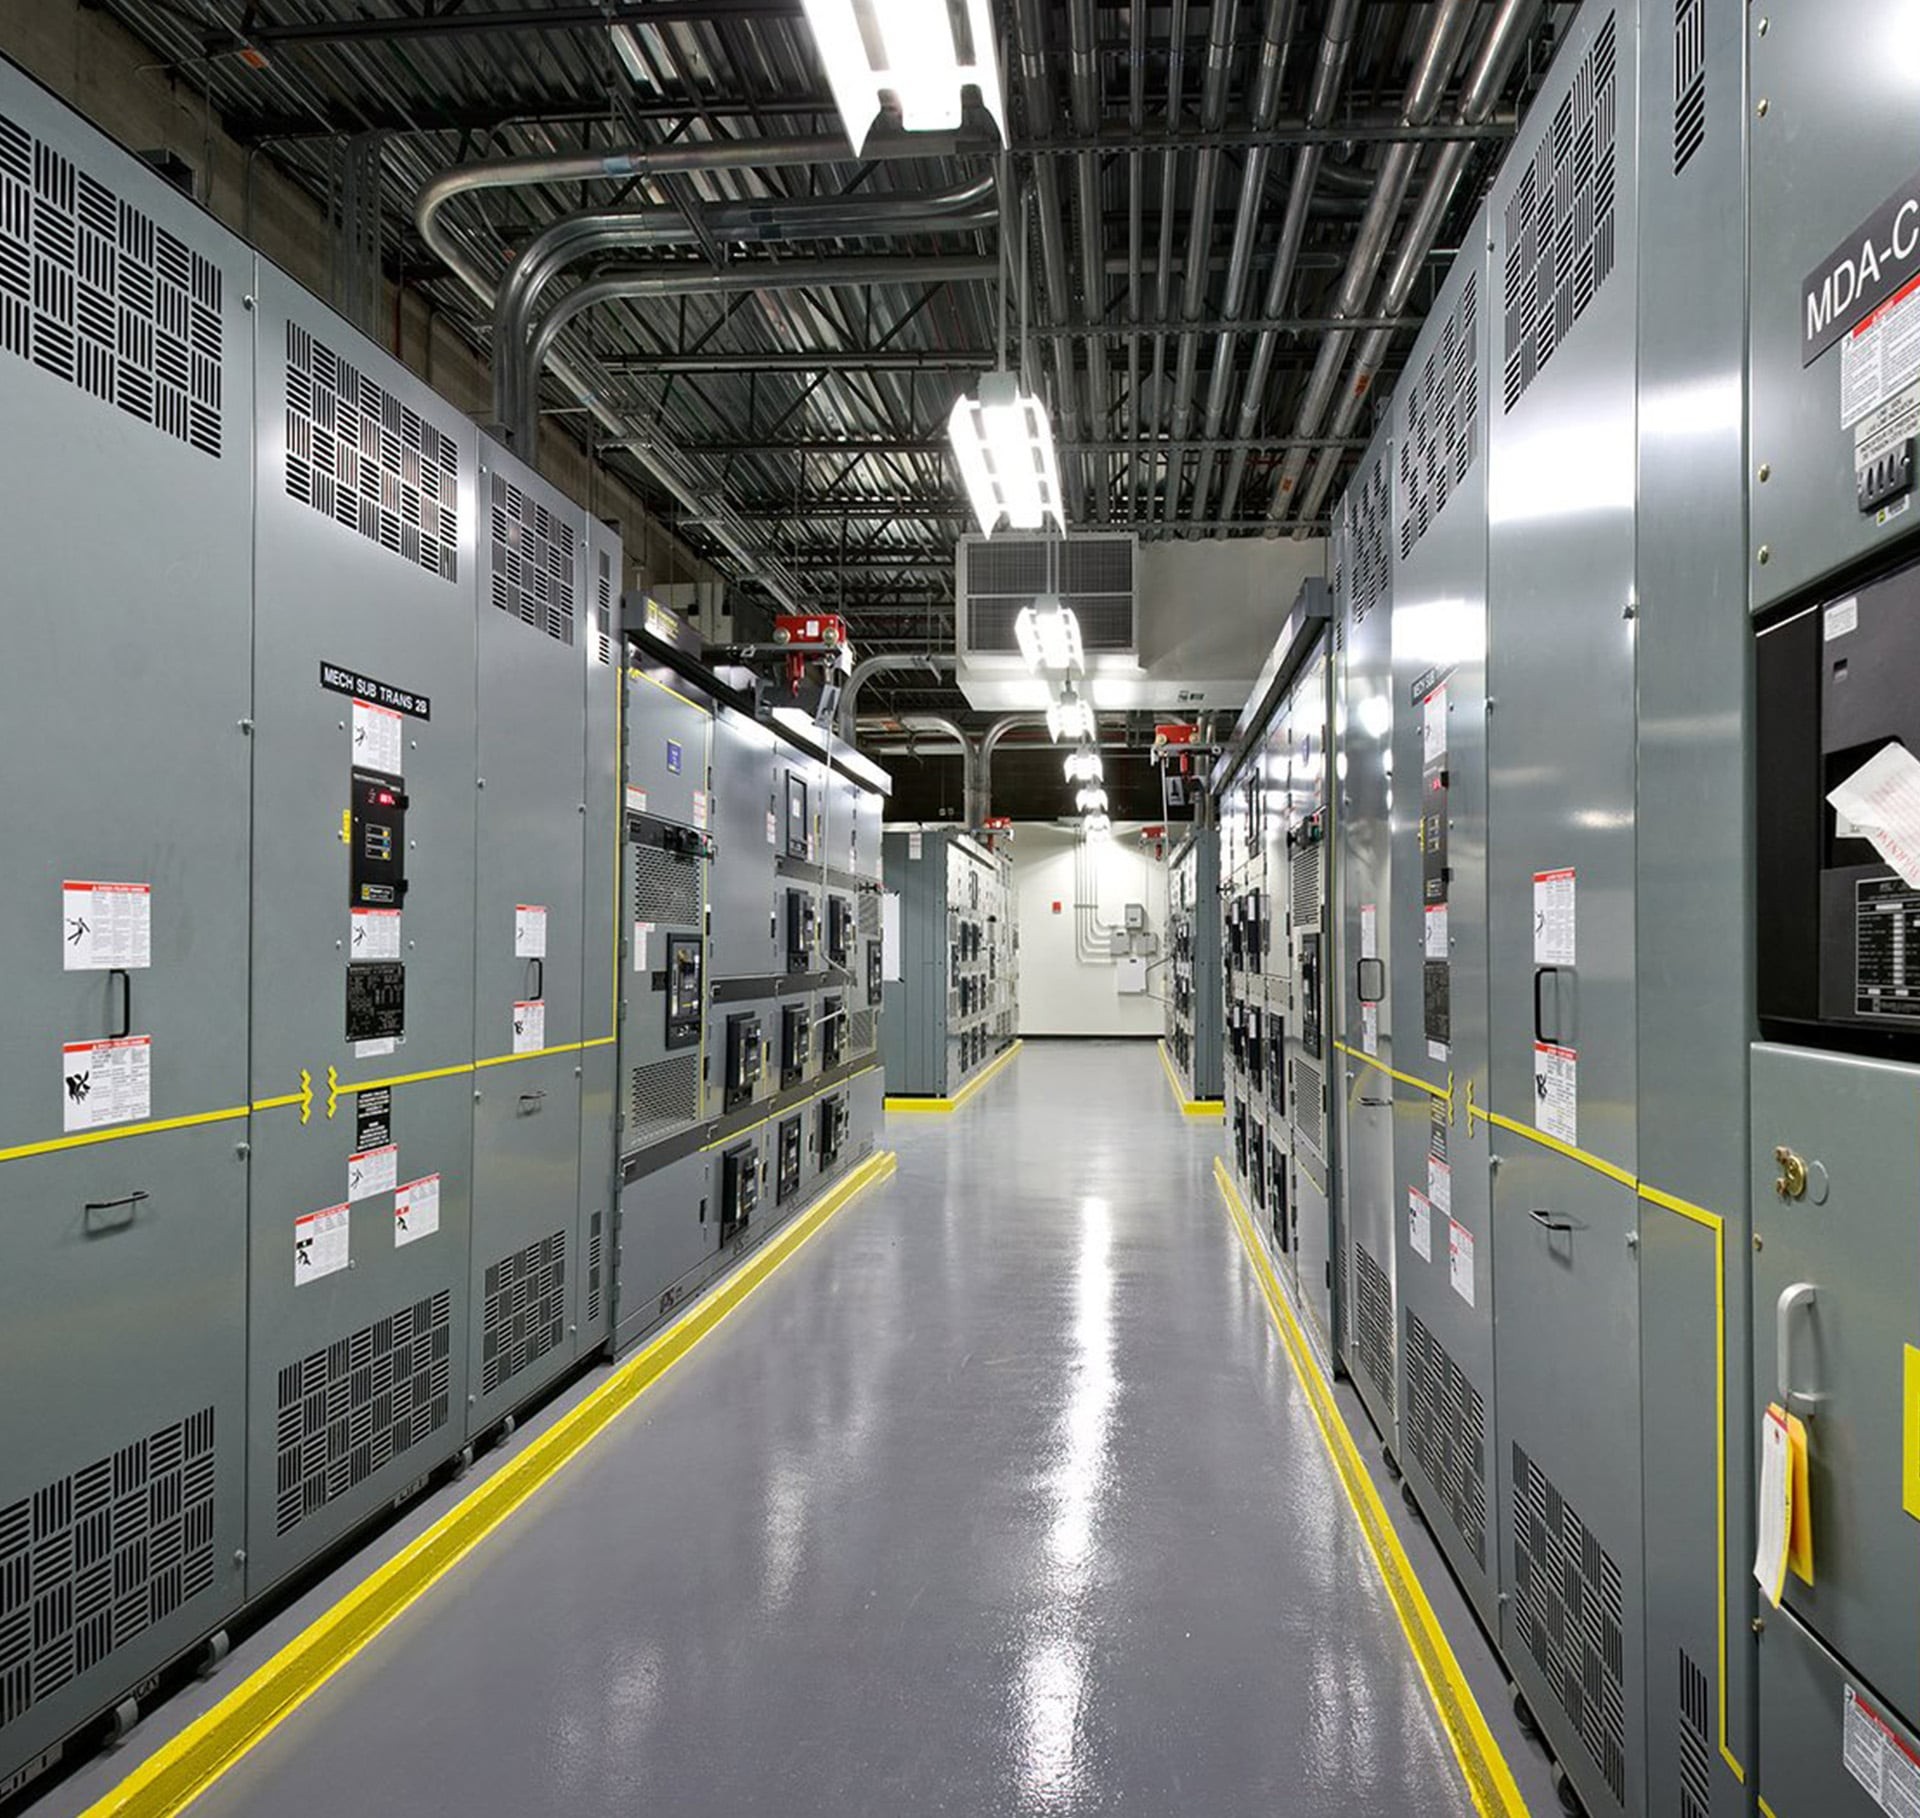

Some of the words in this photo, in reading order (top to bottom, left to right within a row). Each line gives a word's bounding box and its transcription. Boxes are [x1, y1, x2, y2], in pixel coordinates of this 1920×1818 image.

[1807, 198, 1919, 341] MDA-C
[324, 666, 354, 691] MECH
[356, 677, 377, 698] SUB
[380, 686, 413, 709] TRANS
[415, 700, 427, 713] 2B
